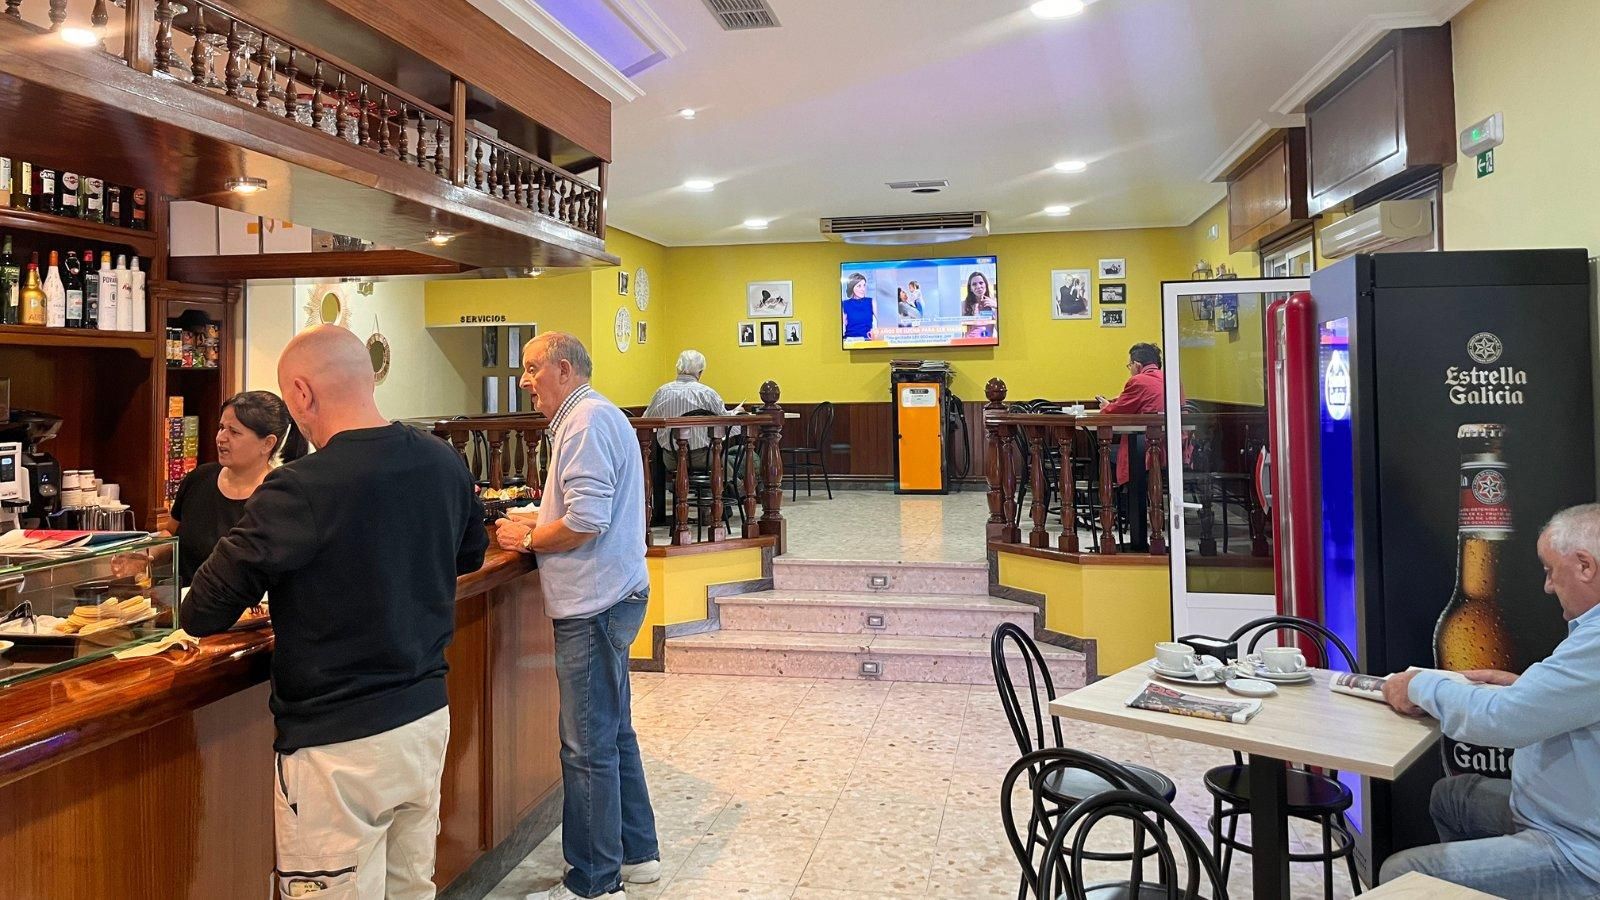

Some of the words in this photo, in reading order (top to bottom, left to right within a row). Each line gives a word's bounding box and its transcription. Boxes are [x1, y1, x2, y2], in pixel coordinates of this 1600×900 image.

[460, 315, 507, 323] SERVICIOS
[1444, 366, 1528, 386] Estrella
[1449, 385, 1524, 405] Galicia
